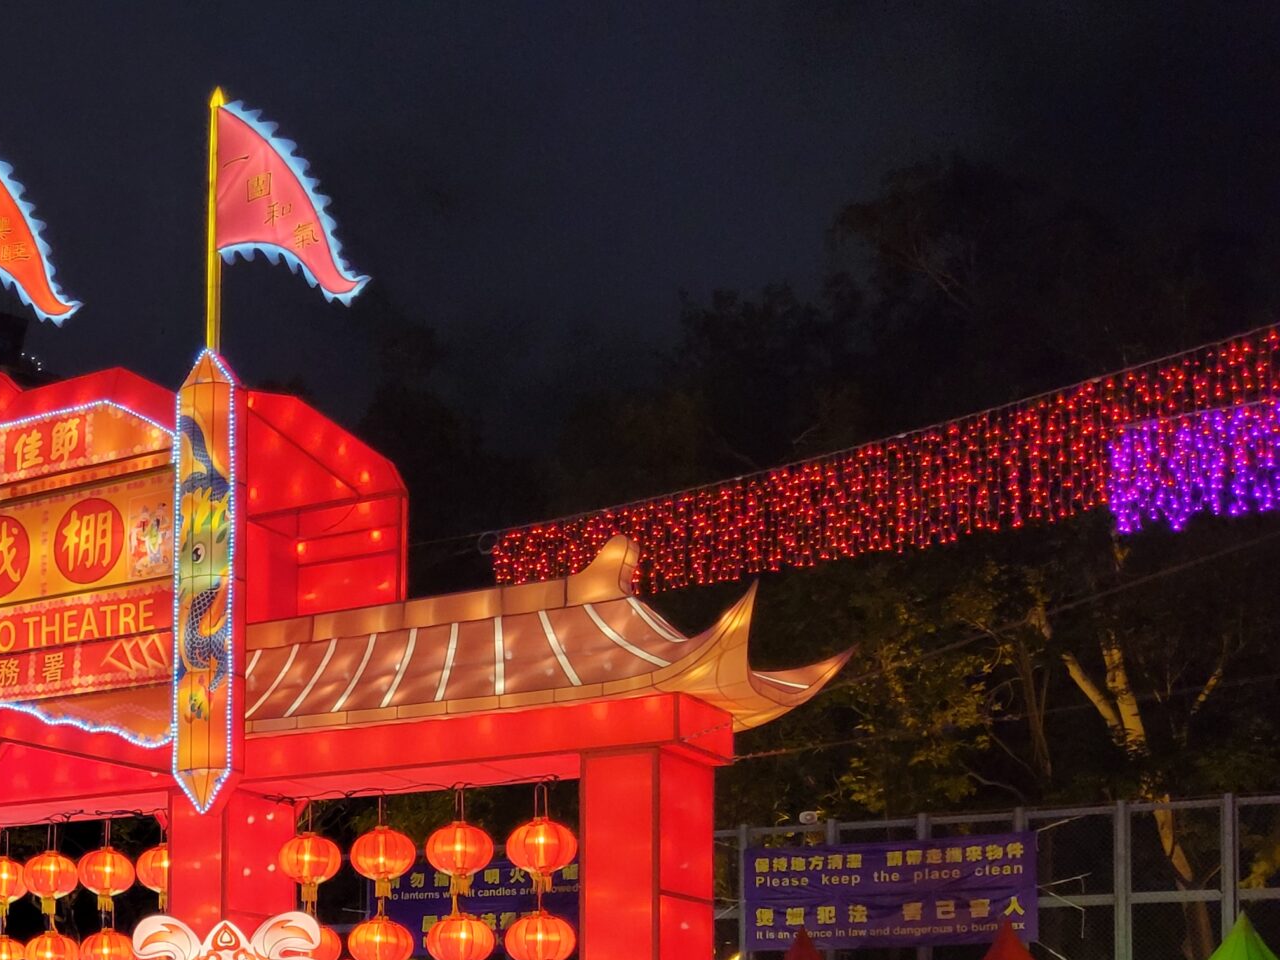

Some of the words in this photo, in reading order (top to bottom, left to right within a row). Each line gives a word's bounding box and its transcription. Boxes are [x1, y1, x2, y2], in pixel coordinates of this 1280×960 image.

[223, 155, 319, 248] 一團和氣
[14, 418, 80, 471] 佳節
[23, 599, 155, 648] THEATRE
[401, 889, 440, 900] lanterns
[477, 887, 517, 898] candles
[755, 875, 809, 887] Please
[821, 873, 861, 886] keep
[873, 870, 900, 882] the
[913, 867, 961, 884] place
[975, 864, 1023, 877] clean
[766, 930, 775, 939] is
[777, 931, 790, 939] an
[835, 928, 846, 937] in
[848, 927, 867, 937] law
[870, 926, 890, 936] and
[893, 924, 952, 937] dangerous
[956, 923, 968, 933] to
[971, 922, 998, 931] burn
